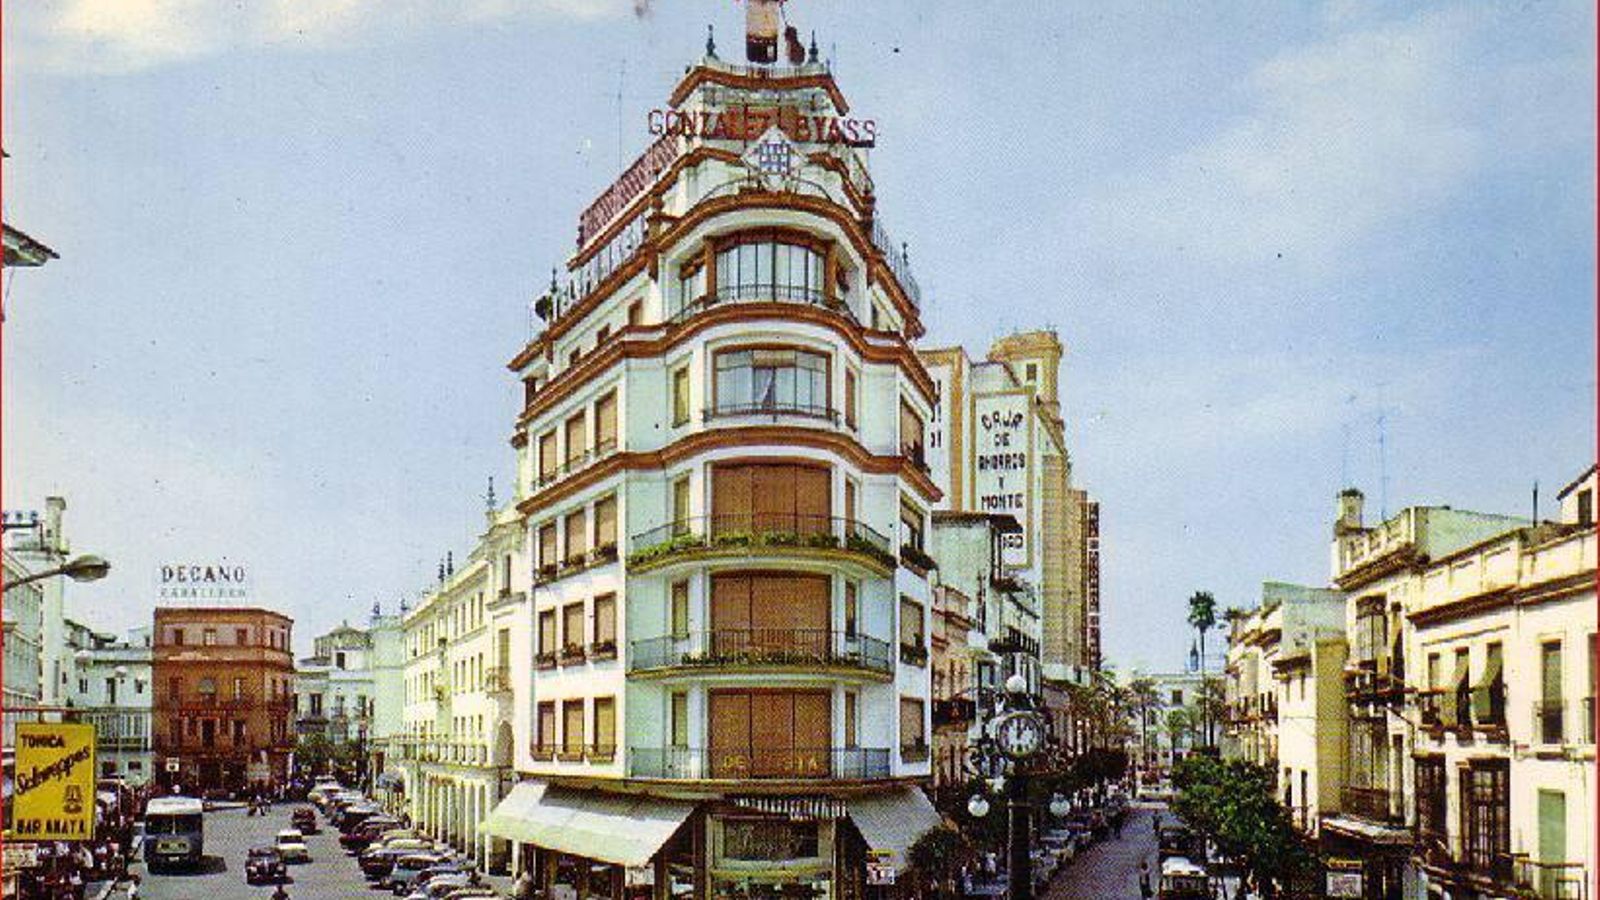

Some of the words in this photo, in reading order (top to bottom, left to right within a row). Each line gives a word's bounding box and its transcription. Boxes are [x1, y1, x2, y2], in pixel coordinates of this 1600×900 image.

[796, 115, 876, 145] BYASS
[980, 409, 1024, 430] CAJA
[994, 431, 1010, 447] DE
[980, 493, 1024, 511] MONTE
[161, 565, 245, 583] DECANO
[16, 746, 91, 795] Schweppes
[16, 818, 41, 834] BAR
